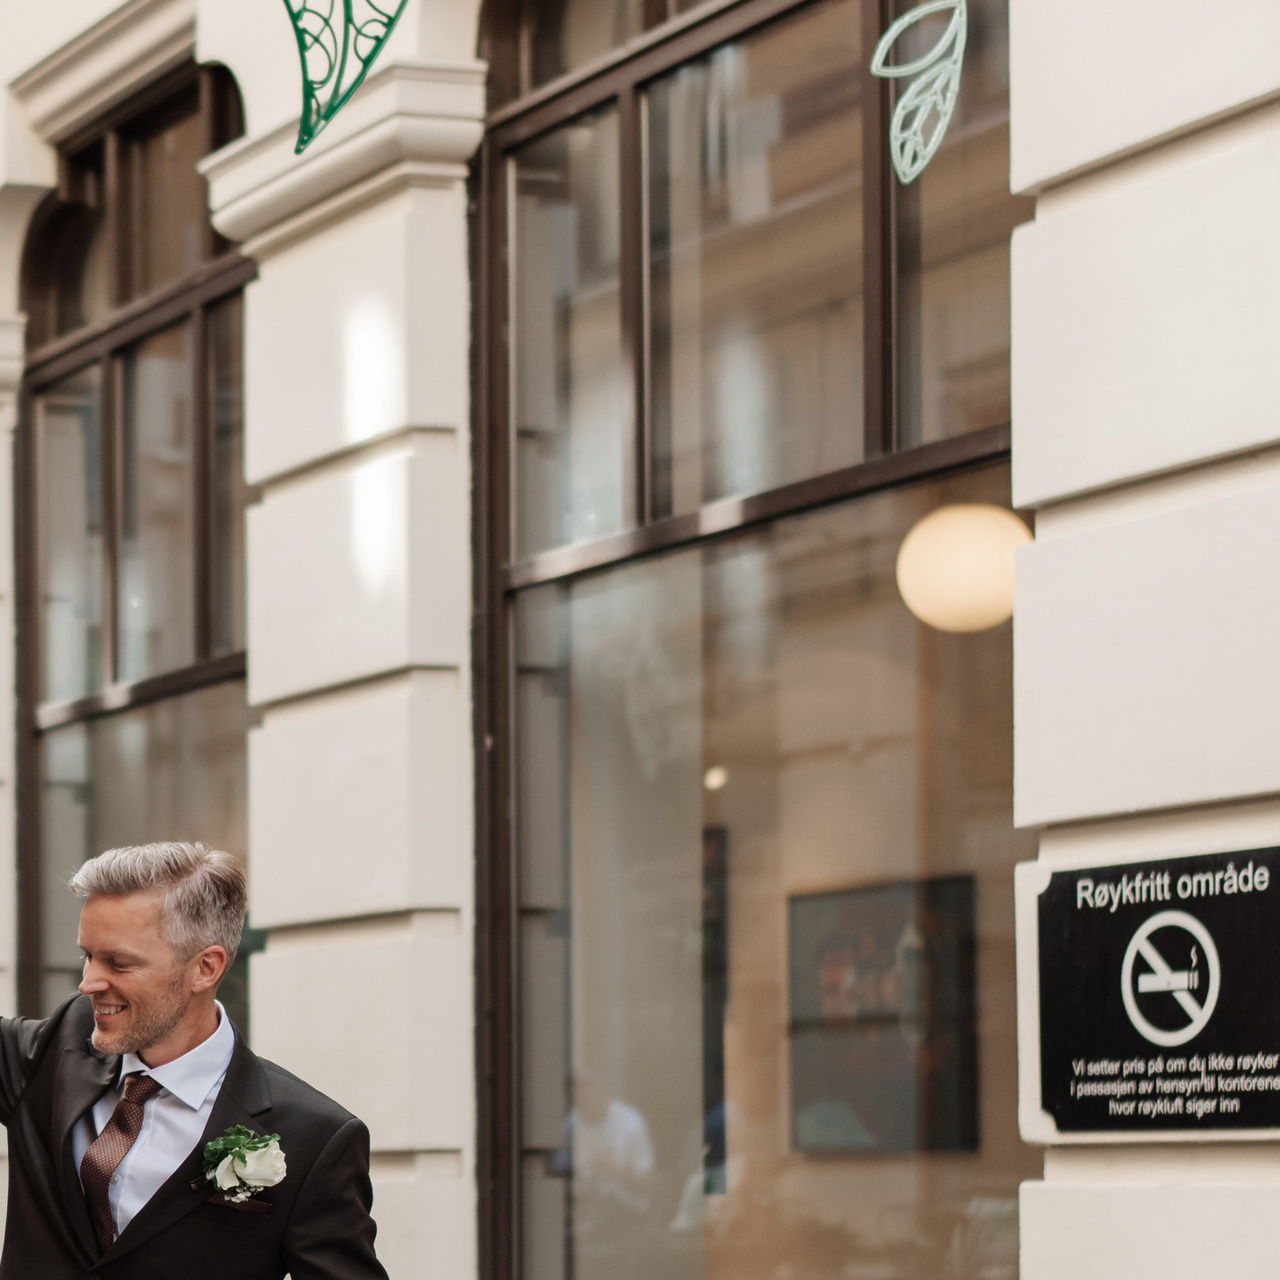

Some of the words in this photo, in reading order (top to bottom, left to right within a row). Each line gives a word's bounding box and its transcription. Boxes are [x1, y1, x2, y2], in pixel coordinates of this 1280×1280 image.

[1076, 870, 1171, 913] Røykfritt
[1177, 860, 1270, 899] område
[1072, 1058, 1086, 1076] Vi
[1087, 1059, 1120, 1076] setter
[1123, 1056, 1146, 1078] pris
[1148, 1054, 1164, 1077] på
[1166, 1058, 1187, 1073] om
[1189, 1053, 1206, 1073] du
[1208, 1052, 1235, 1071] ikke
[1237, 1051, 1280, 1074] røyker
[1077, 1078, 1137, 1100] passasjen
[1138, 1080, 1154, 1094] av
[1156, 1077, 1201, 1097] hensyn
[1204, 1074, 1216, 1092] til
[1109, 1098, 1136, 1115] hvor
[1138, 1096, 1183, 1118] røykluft
[1220, 1095, 1240, 1113] inn
